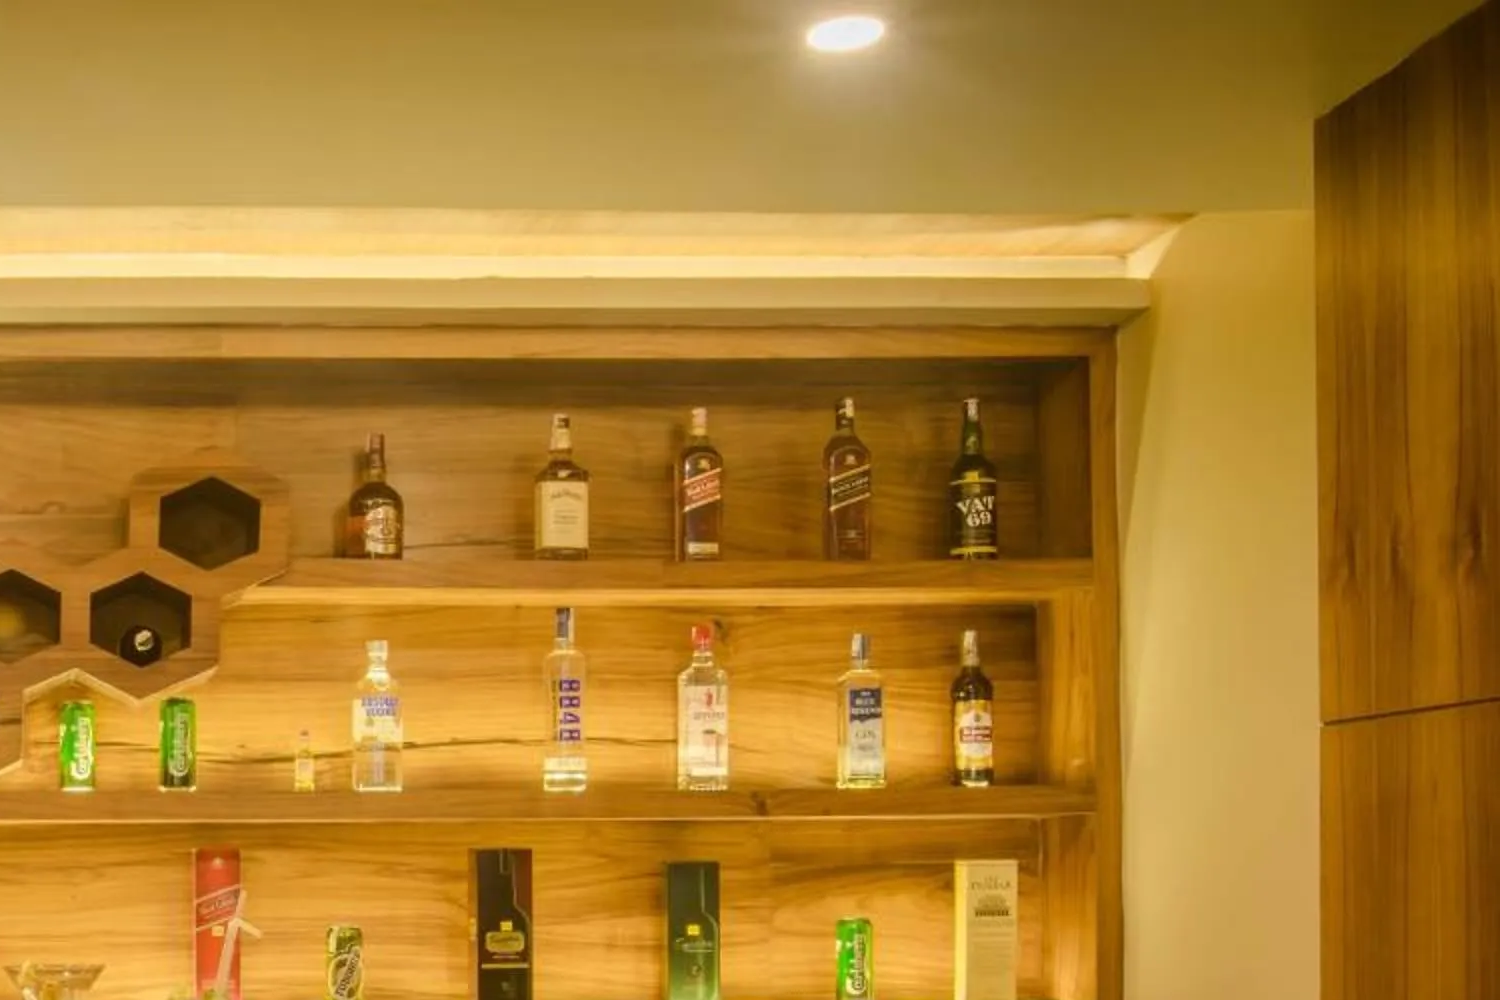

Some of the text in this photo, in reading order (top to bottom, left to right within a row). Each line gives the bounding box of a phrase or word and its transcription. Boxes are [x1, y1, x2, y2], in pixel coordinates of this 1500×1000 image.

[956, 495, 995, 515] VAT
[966, 511, 992, 527] 69
[559, 679, 580, 741] 8848
